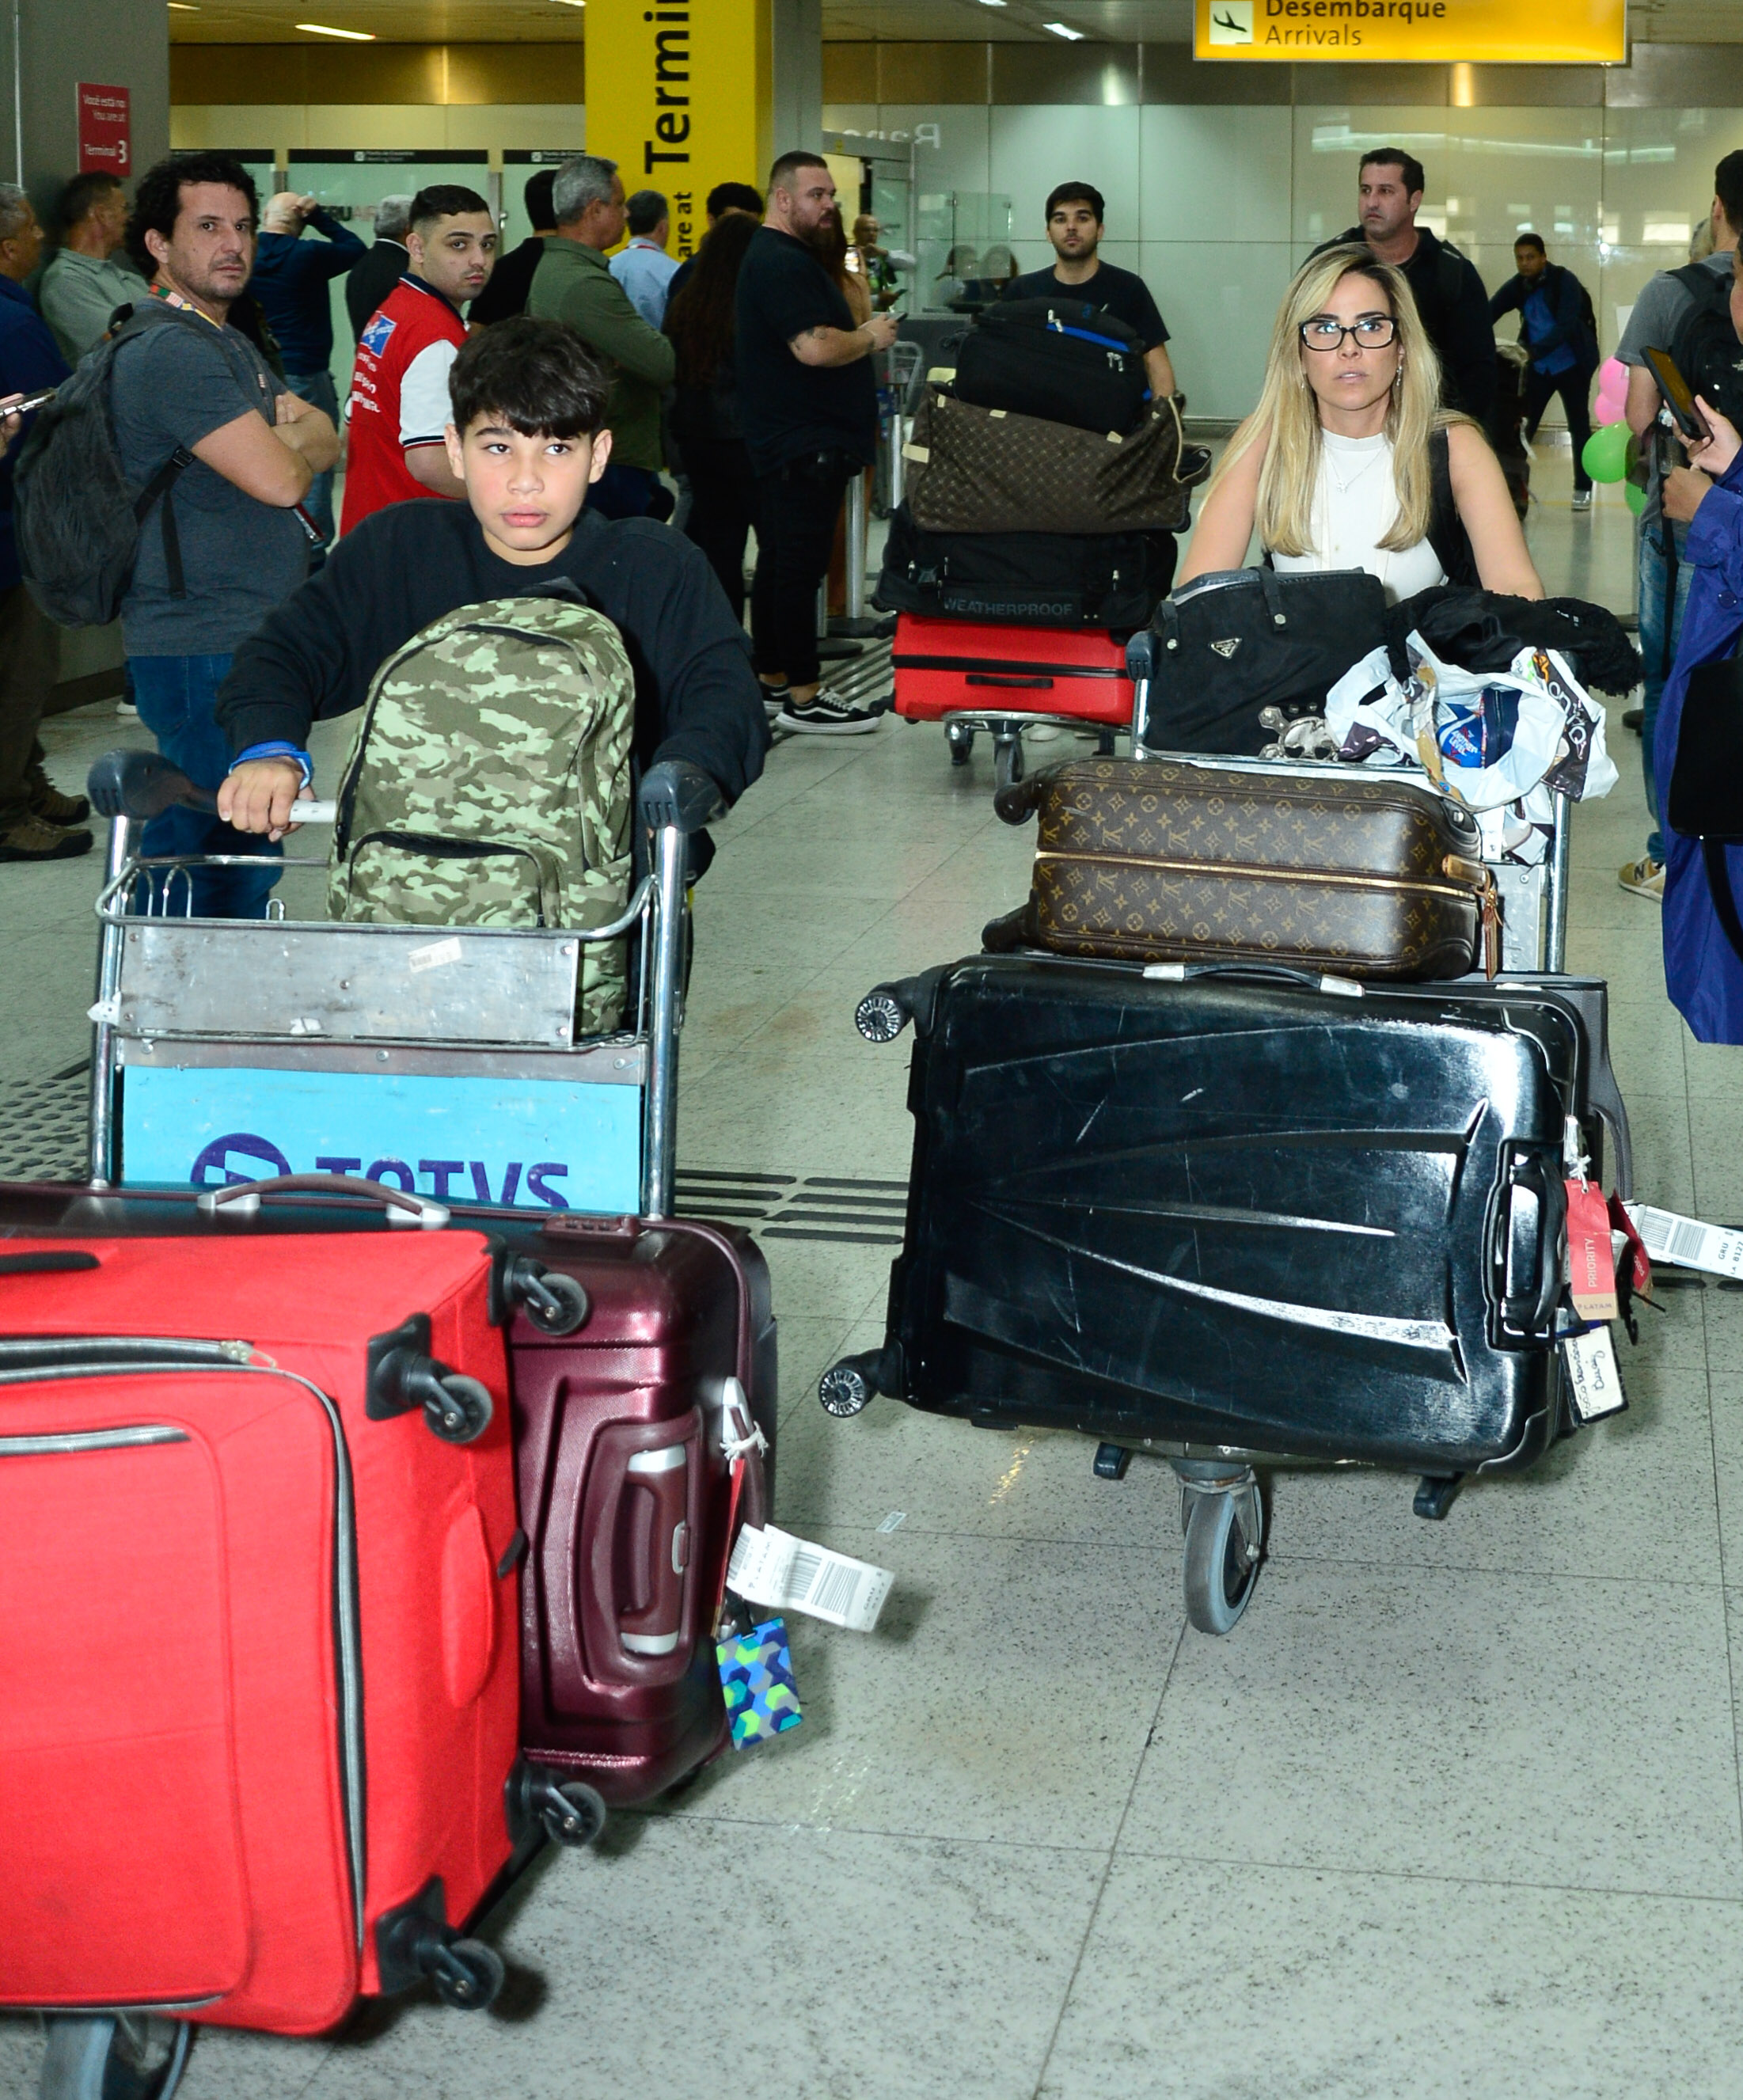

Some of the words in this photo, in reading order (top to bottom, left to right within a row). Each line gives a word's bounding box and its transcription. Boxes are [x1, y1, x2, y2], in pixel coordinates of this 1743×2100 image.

[1266, 0, 1446, 25] Desembarque
[1265, 24, 1362, 46] Arrivals
[644, 0, 690, 174] Termi
[84, 143, 117, 157] Terminal
[118, 139, 127, 165] 3
[674, 192, 693, 215] at
[678, 222, 693, 258] are
[944, 597, 1073, 616] WEATHERPROOF
[1585, 1237, 1597, 1288] PRIORITY
[1718, 1242, 1730, 1260] GRU
[1585, 1302, 1612, 1311] LATAM
